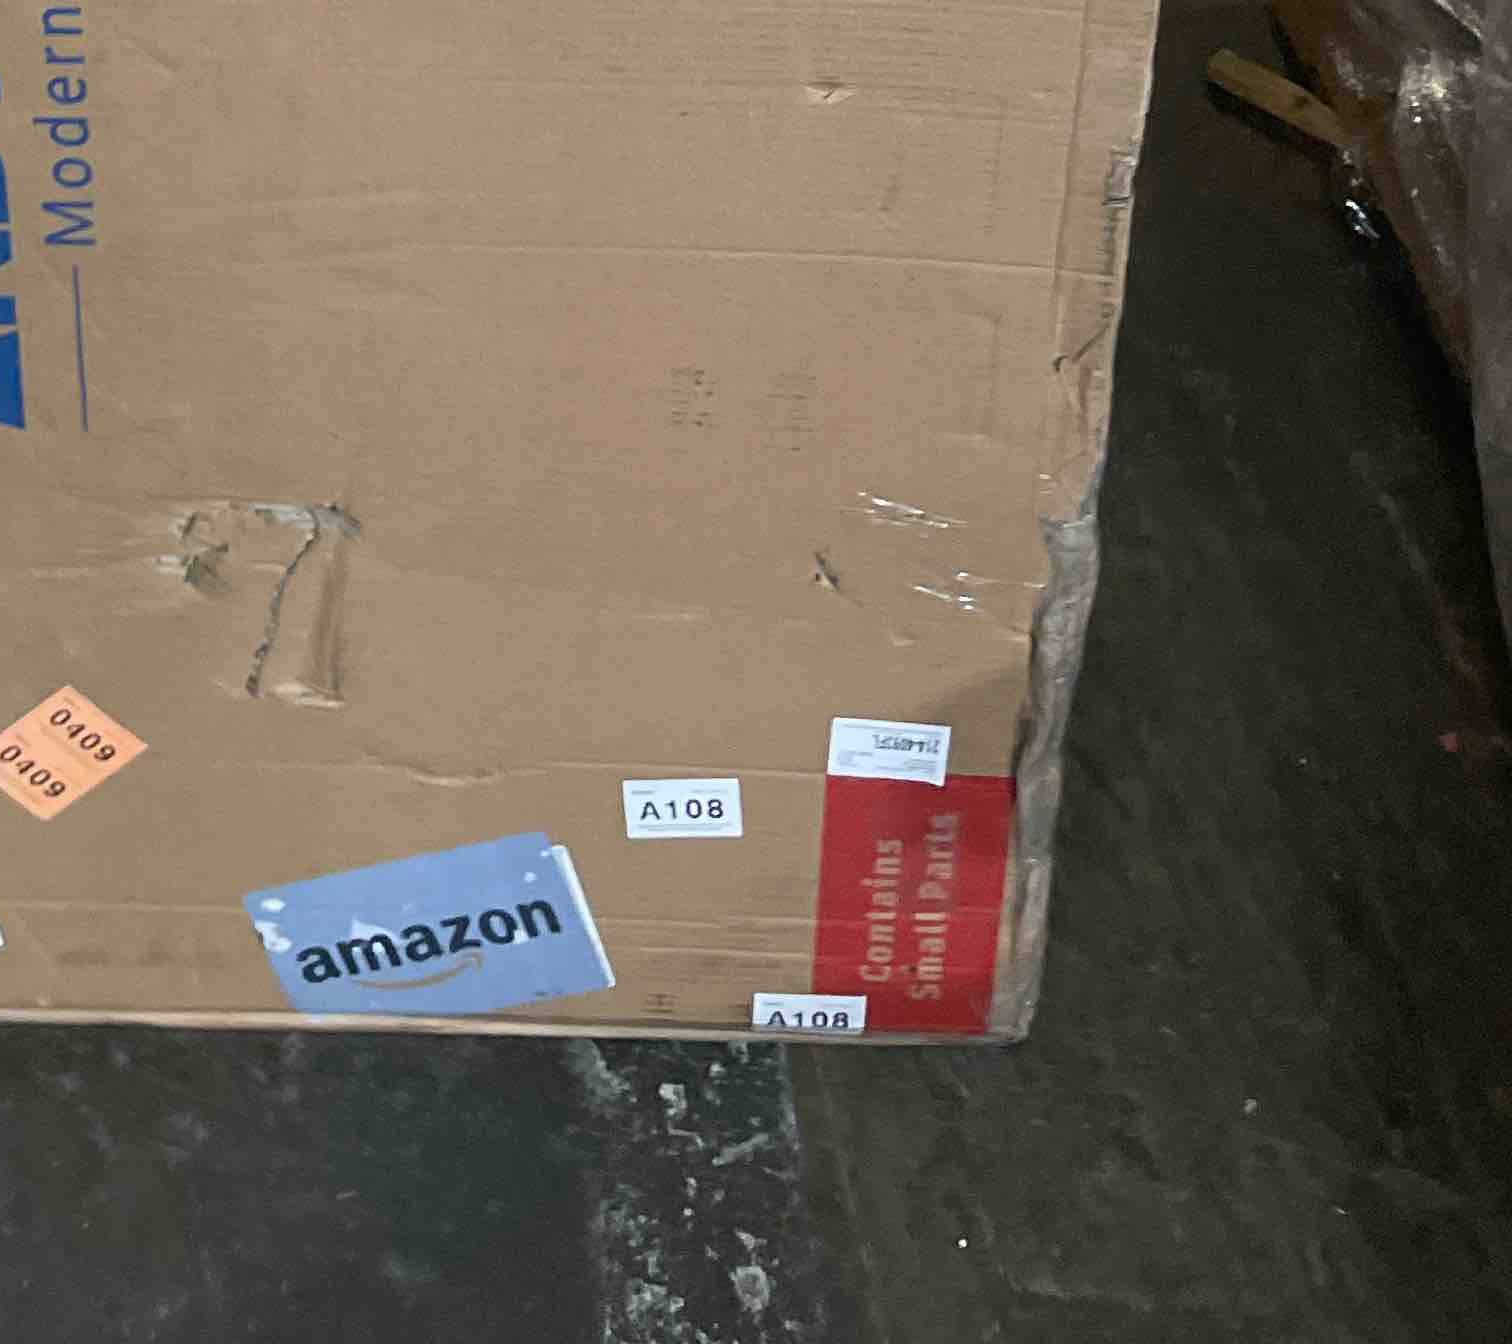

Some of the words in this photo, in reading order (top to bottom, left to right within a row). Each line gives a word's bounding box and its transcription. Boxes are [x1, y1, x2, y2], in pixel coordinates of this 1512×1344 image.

[33, 6, 96, 247] Modern
[0, 744, 66, 797] 0409
[49, 708, 116, 761] 0409
[640, 799, 724, 821] A108
[919, 814, 960, 900] Parts
[296, 898, 564, 984] amazon
[859, 839, 904, 982] Contains
[909, 912, 947, 1000] Small
[767, 1011, 849, 1029] A108
